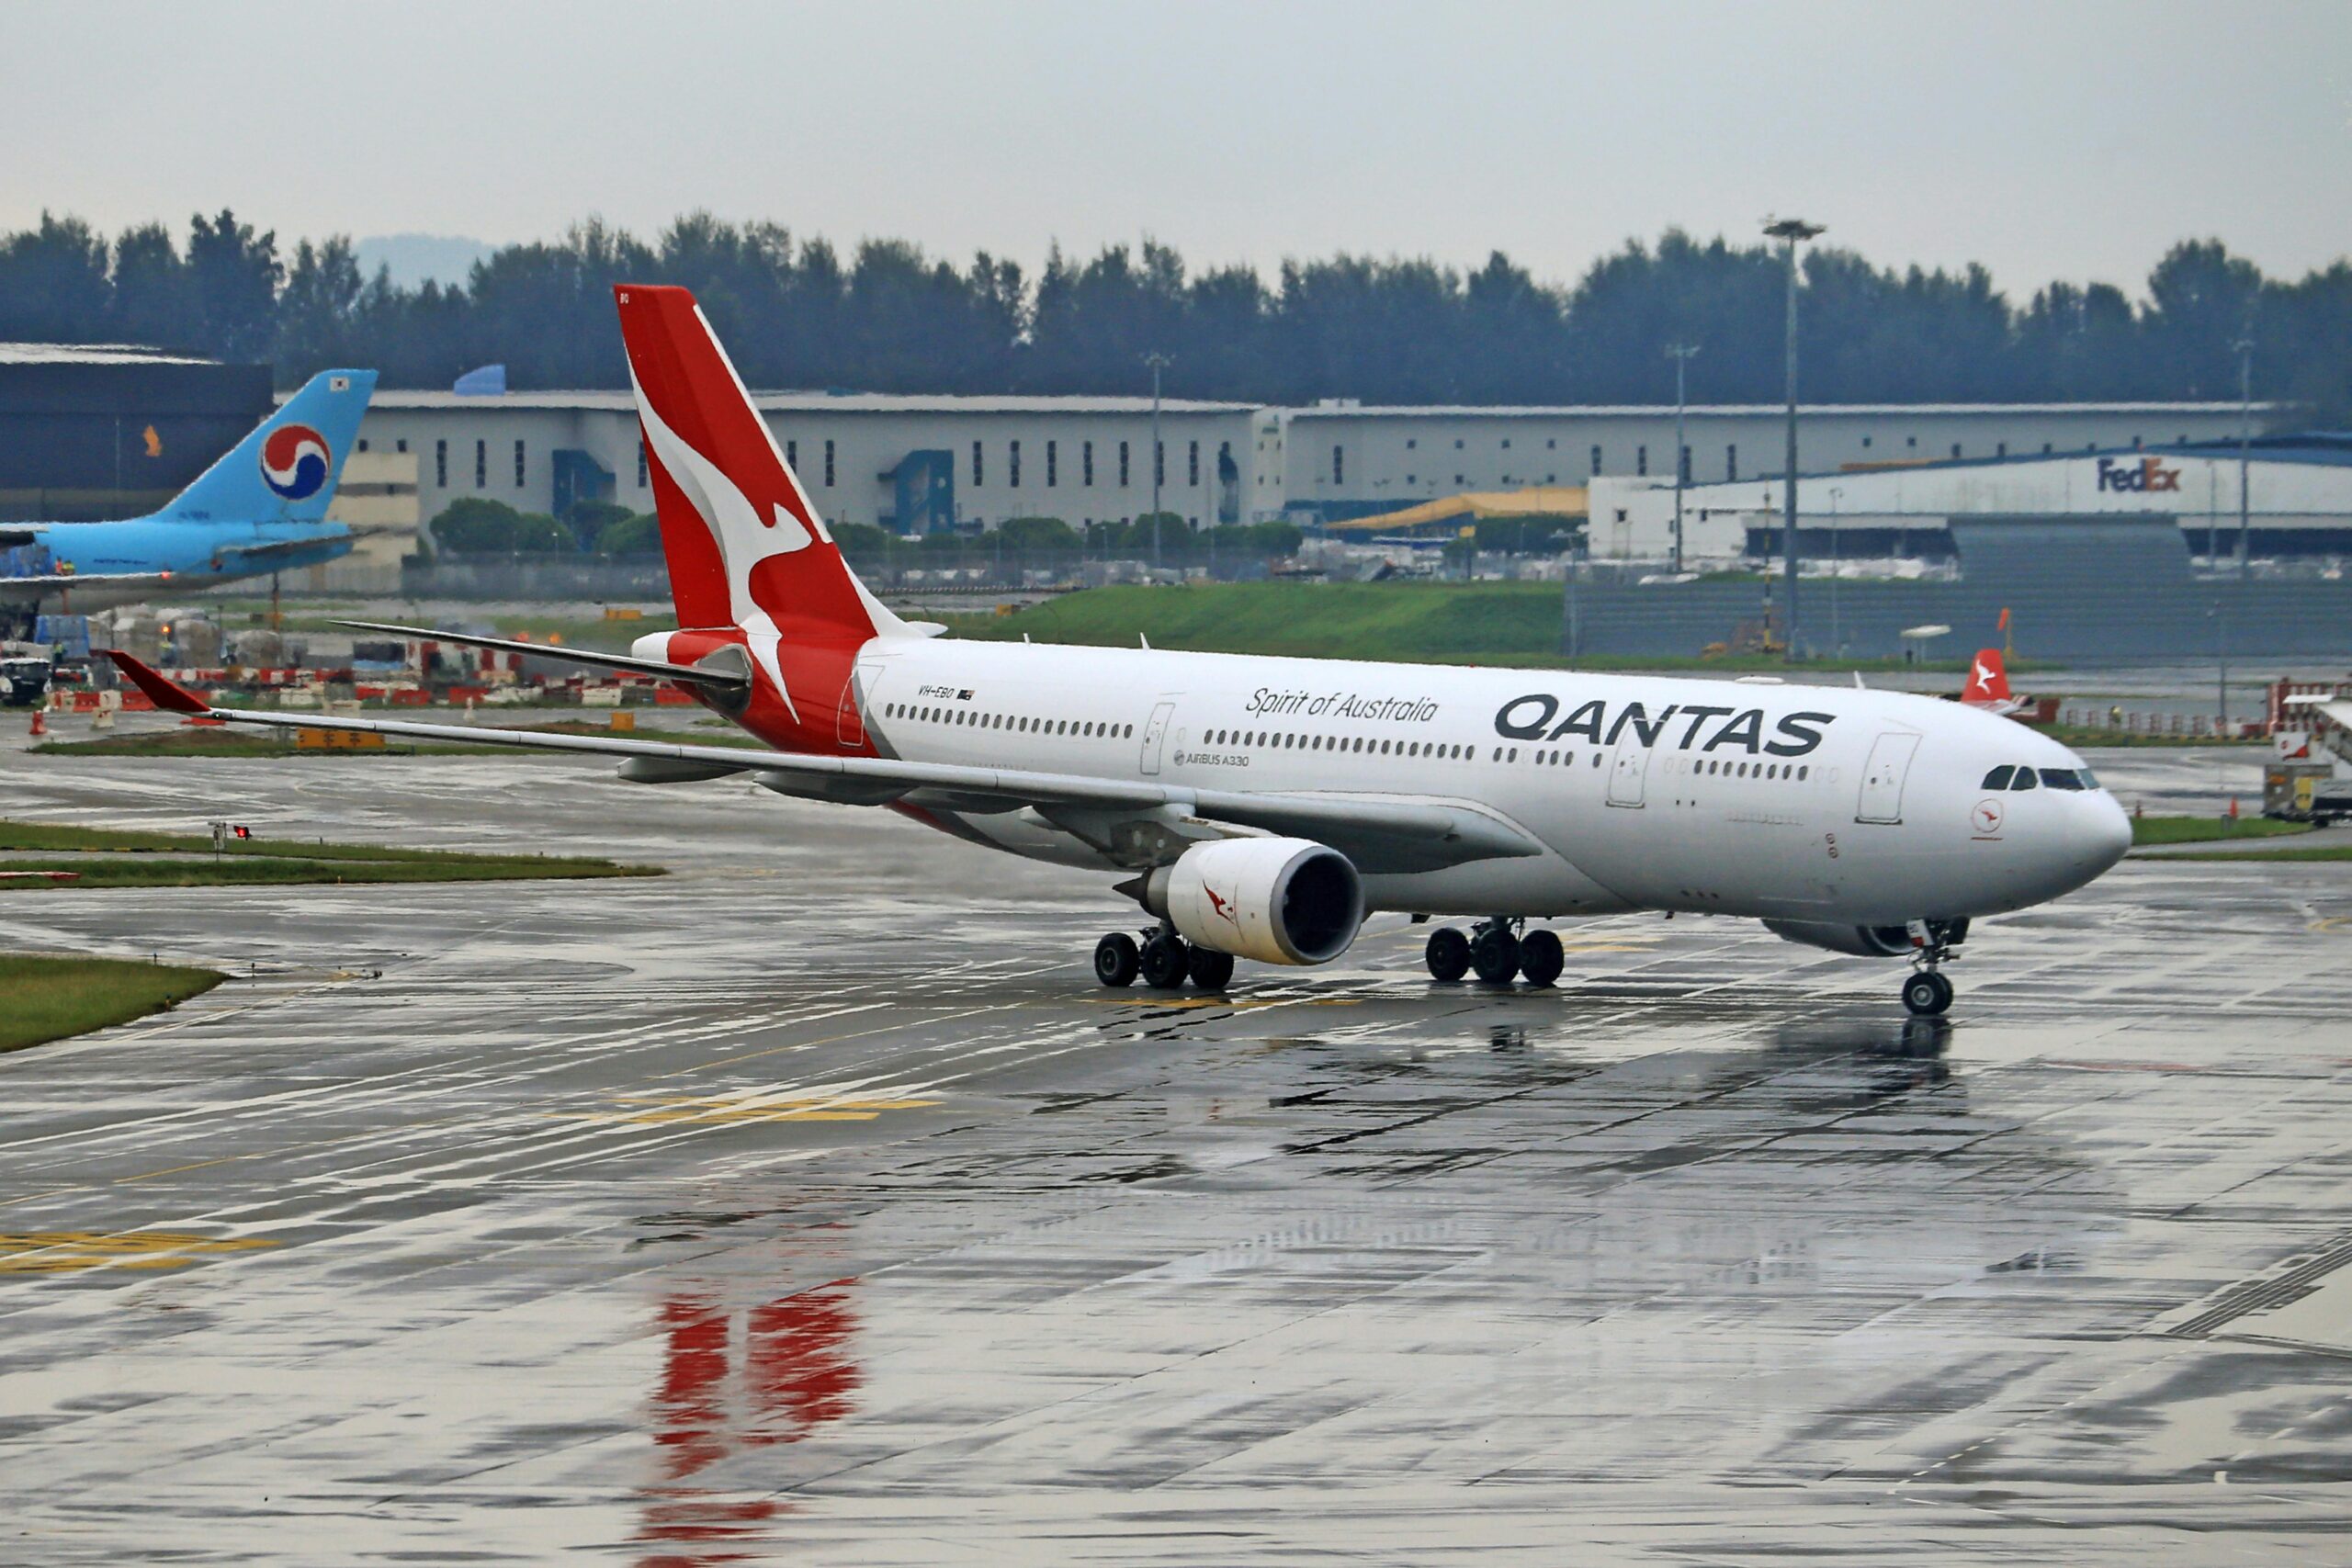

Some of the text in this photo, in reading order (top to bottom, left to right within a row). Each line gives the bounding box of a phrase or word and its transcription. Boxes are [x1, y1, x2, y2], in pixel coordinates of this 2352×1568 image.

[2097, 458, 2182, 492] FedEx
[919, 684, 955, 699] VH-EBO
[1246, 687, 1440, 722] Spirit of Australia
[1494, 693, 1838, 758] QANTAS
[1185, 753, 1250, 767] AIRBUS A330
